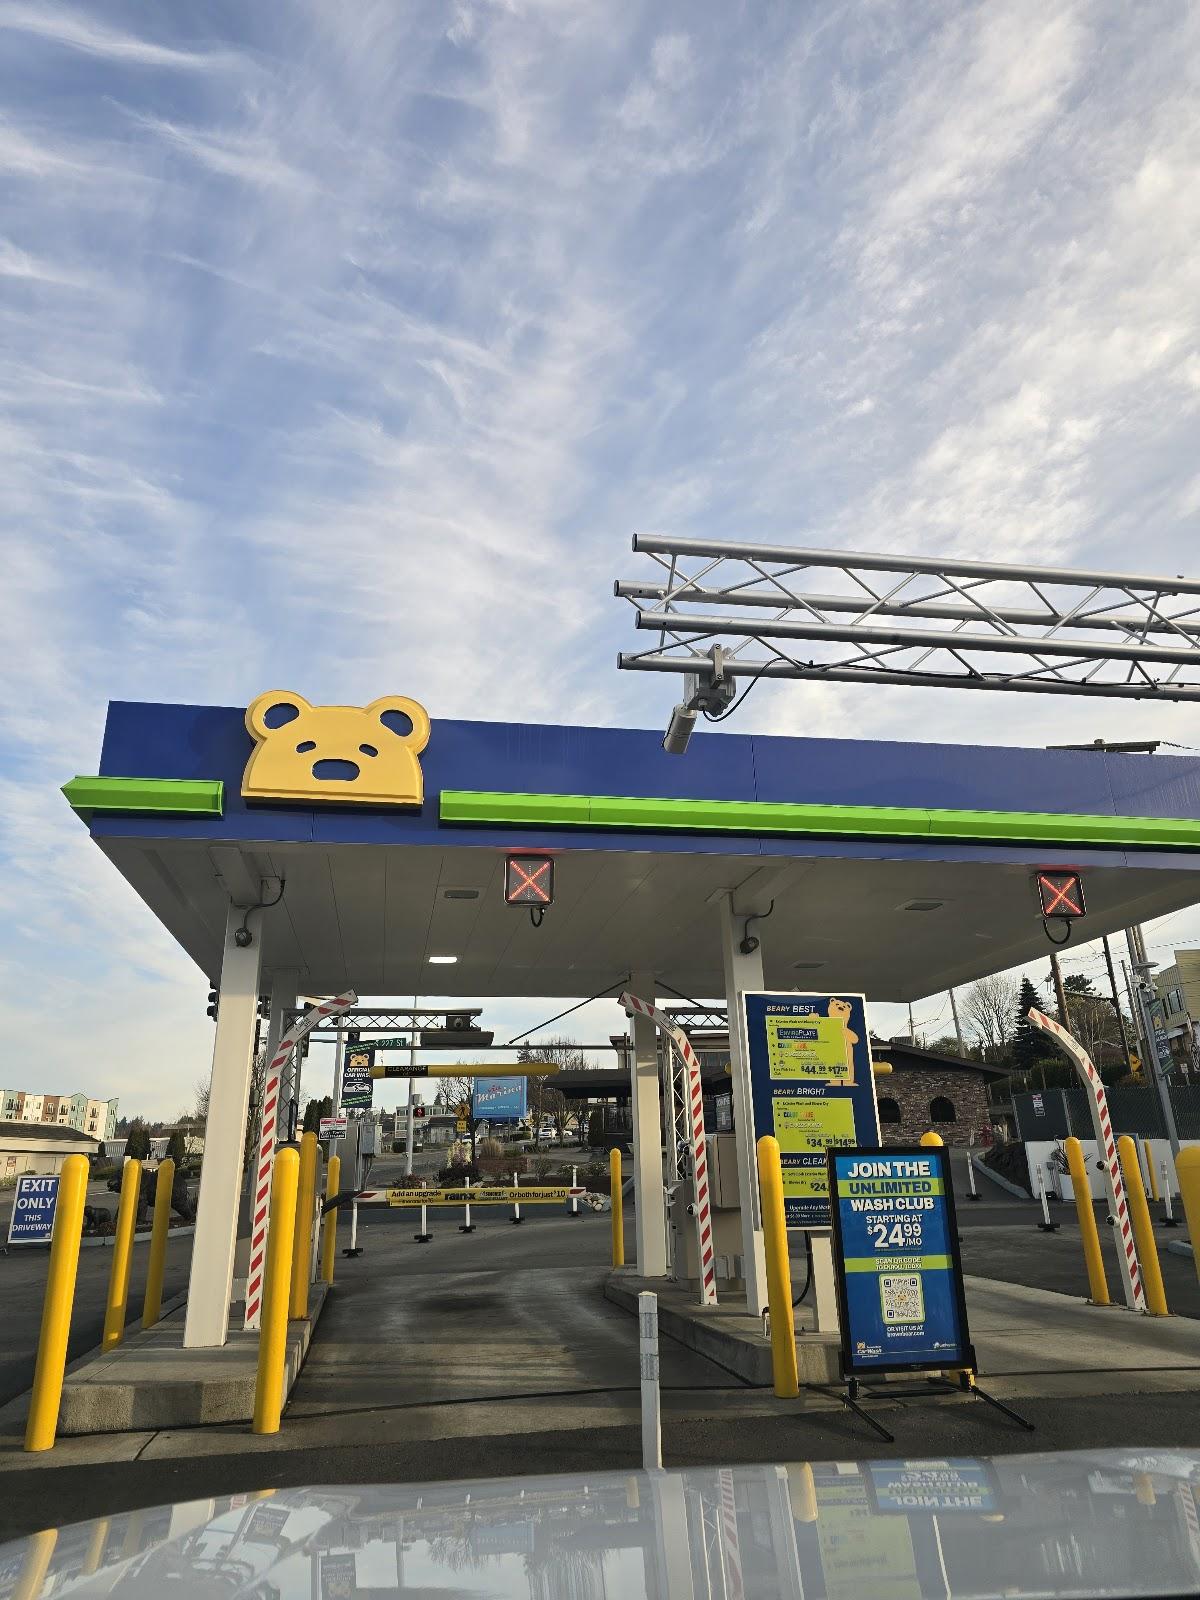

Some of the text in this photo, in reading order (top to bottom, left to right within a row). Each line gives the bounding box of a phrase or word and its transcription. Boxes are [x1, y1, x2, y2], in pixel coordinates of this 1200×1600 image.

[792, 1005, 816, 1013] BEST
[381, 1039, 394, 1047] 227
[396, 1039, 403, 1047] St
[796, 1087, 826, 1096] BRIGHT
[848, 1161, 931, 1178] JOIN THE
[21, 1179, 56, 1192] EXIT
[810, 1182, 830, 1192] $24.
[849, 1181, 932, 1195] UNLIMITED
[414, 1190, 441, 1198] upgrade
[517, 1190, 532, 1198] both
[541, 1190, 553, 1199] just
[17, 1197, 55, 1209] ONLY
[851, 1197, 934, 1212] WASH CLUB
[24, 1214, 42, 1222] THIS
[865, 1214, 922, 1224] STARTING AT
[12, 1223, 52, 1231] DRIVEWAY
